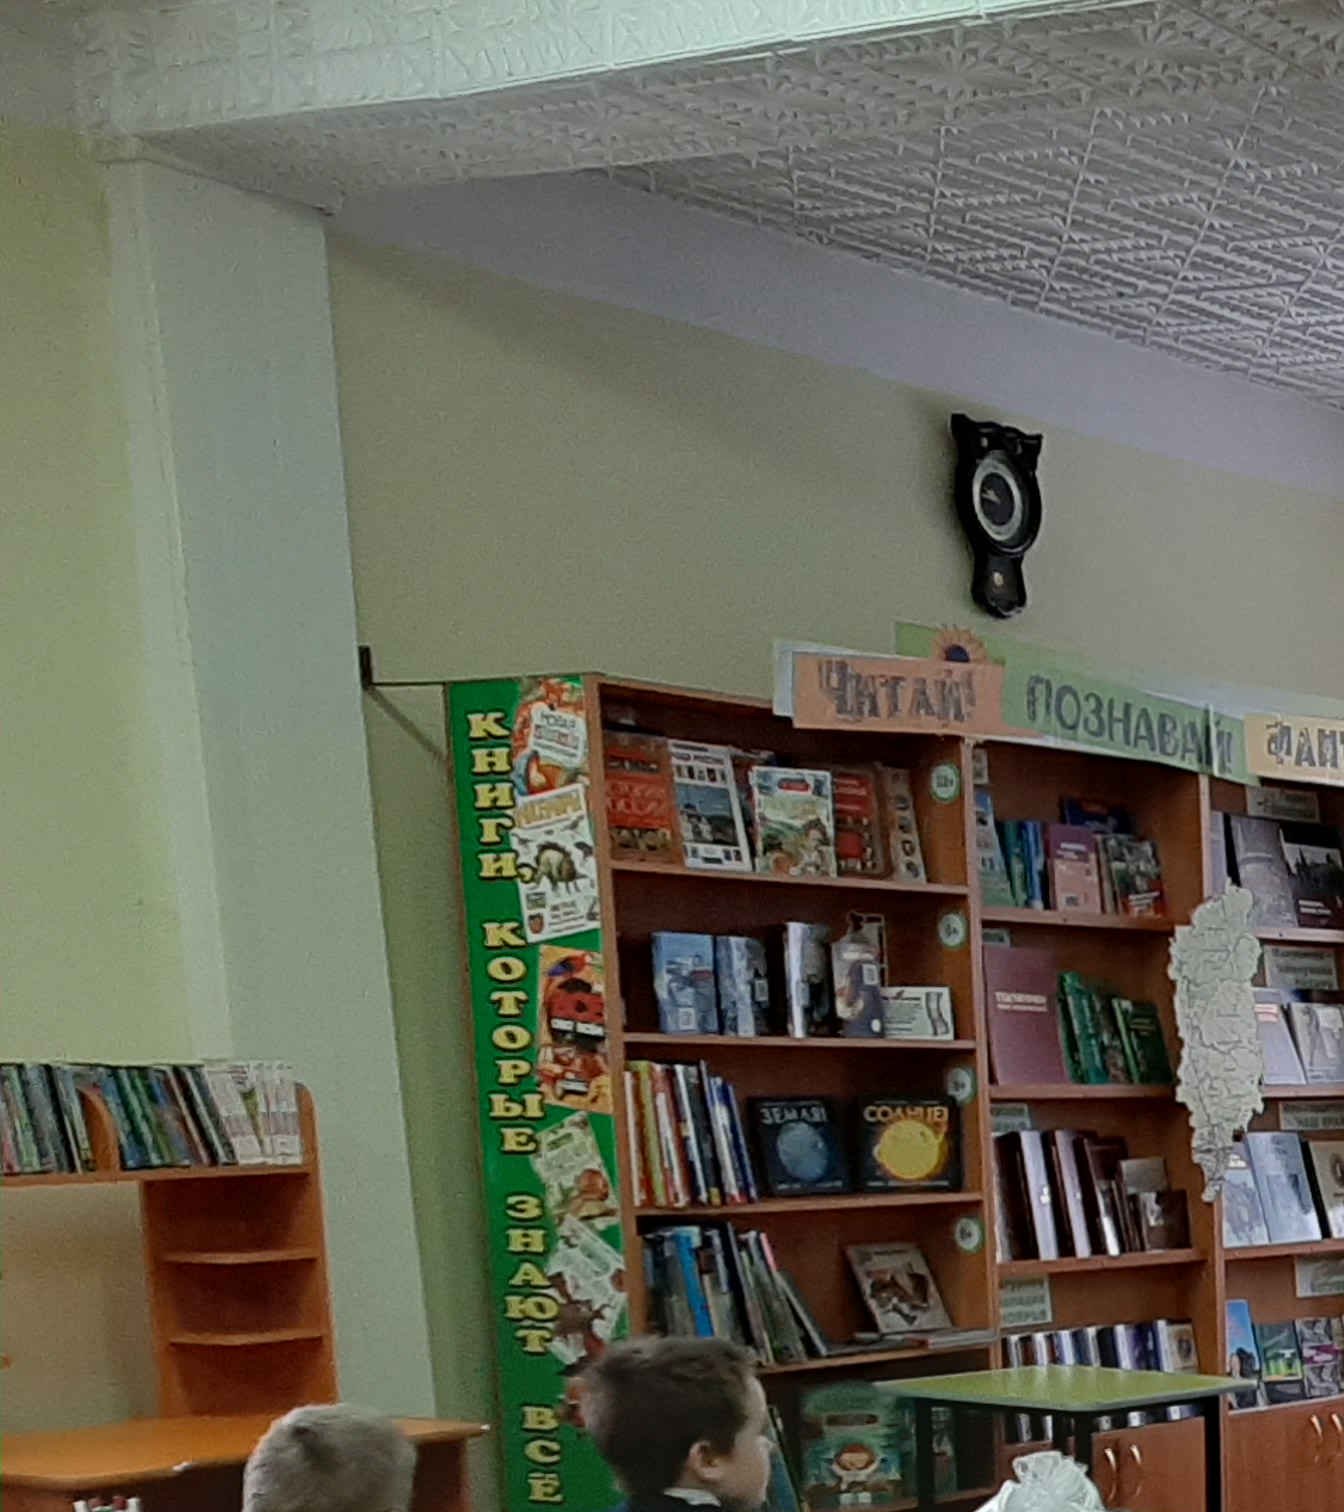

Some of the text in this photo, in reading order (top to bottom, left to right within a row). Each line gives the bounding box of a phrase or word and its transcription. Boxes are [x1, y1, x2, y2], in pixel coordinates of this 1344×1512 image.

[817, 659, 977, 724] ЧИТАЙ!
[1026, 674, 1233, 774] ПОЗНАВАЙ!
[482, 922, 543, 1154] КОТОРЫЕ
[505, 1194, 561, 1354] ЗНАЮТ
[522, 1405, 562, 1504] ВСЁ
